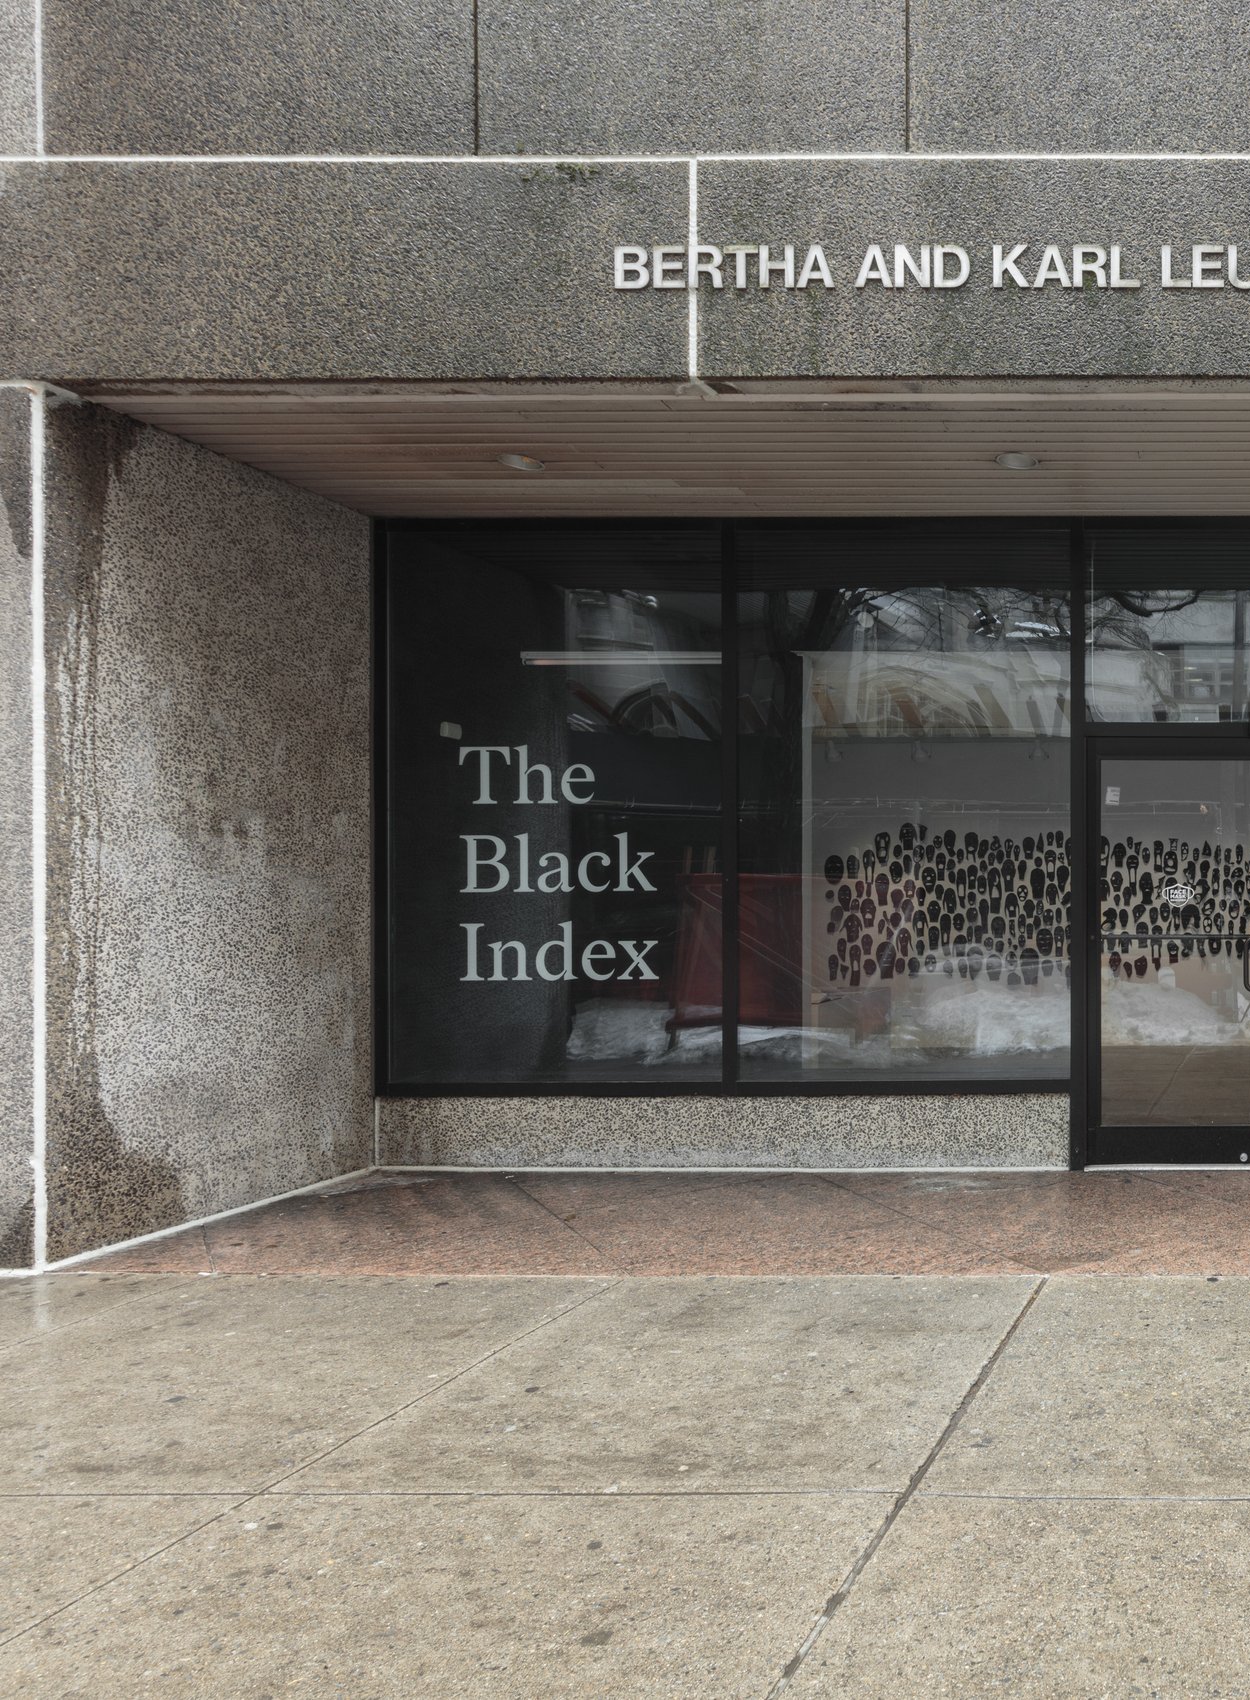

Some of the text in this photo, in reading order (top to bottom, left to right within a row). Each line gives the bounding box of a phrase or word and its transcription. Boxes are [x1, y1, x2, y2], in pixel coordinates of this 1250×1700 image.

[613, 244, 837, 290] BERTHA
[853, 243, 971, 289] AND
[991, 243, 1141, 289] KARL
[458, 743, 596, 805] The
[458, 831, 658, 893] Black
[459, 920, 660, 982] Index
